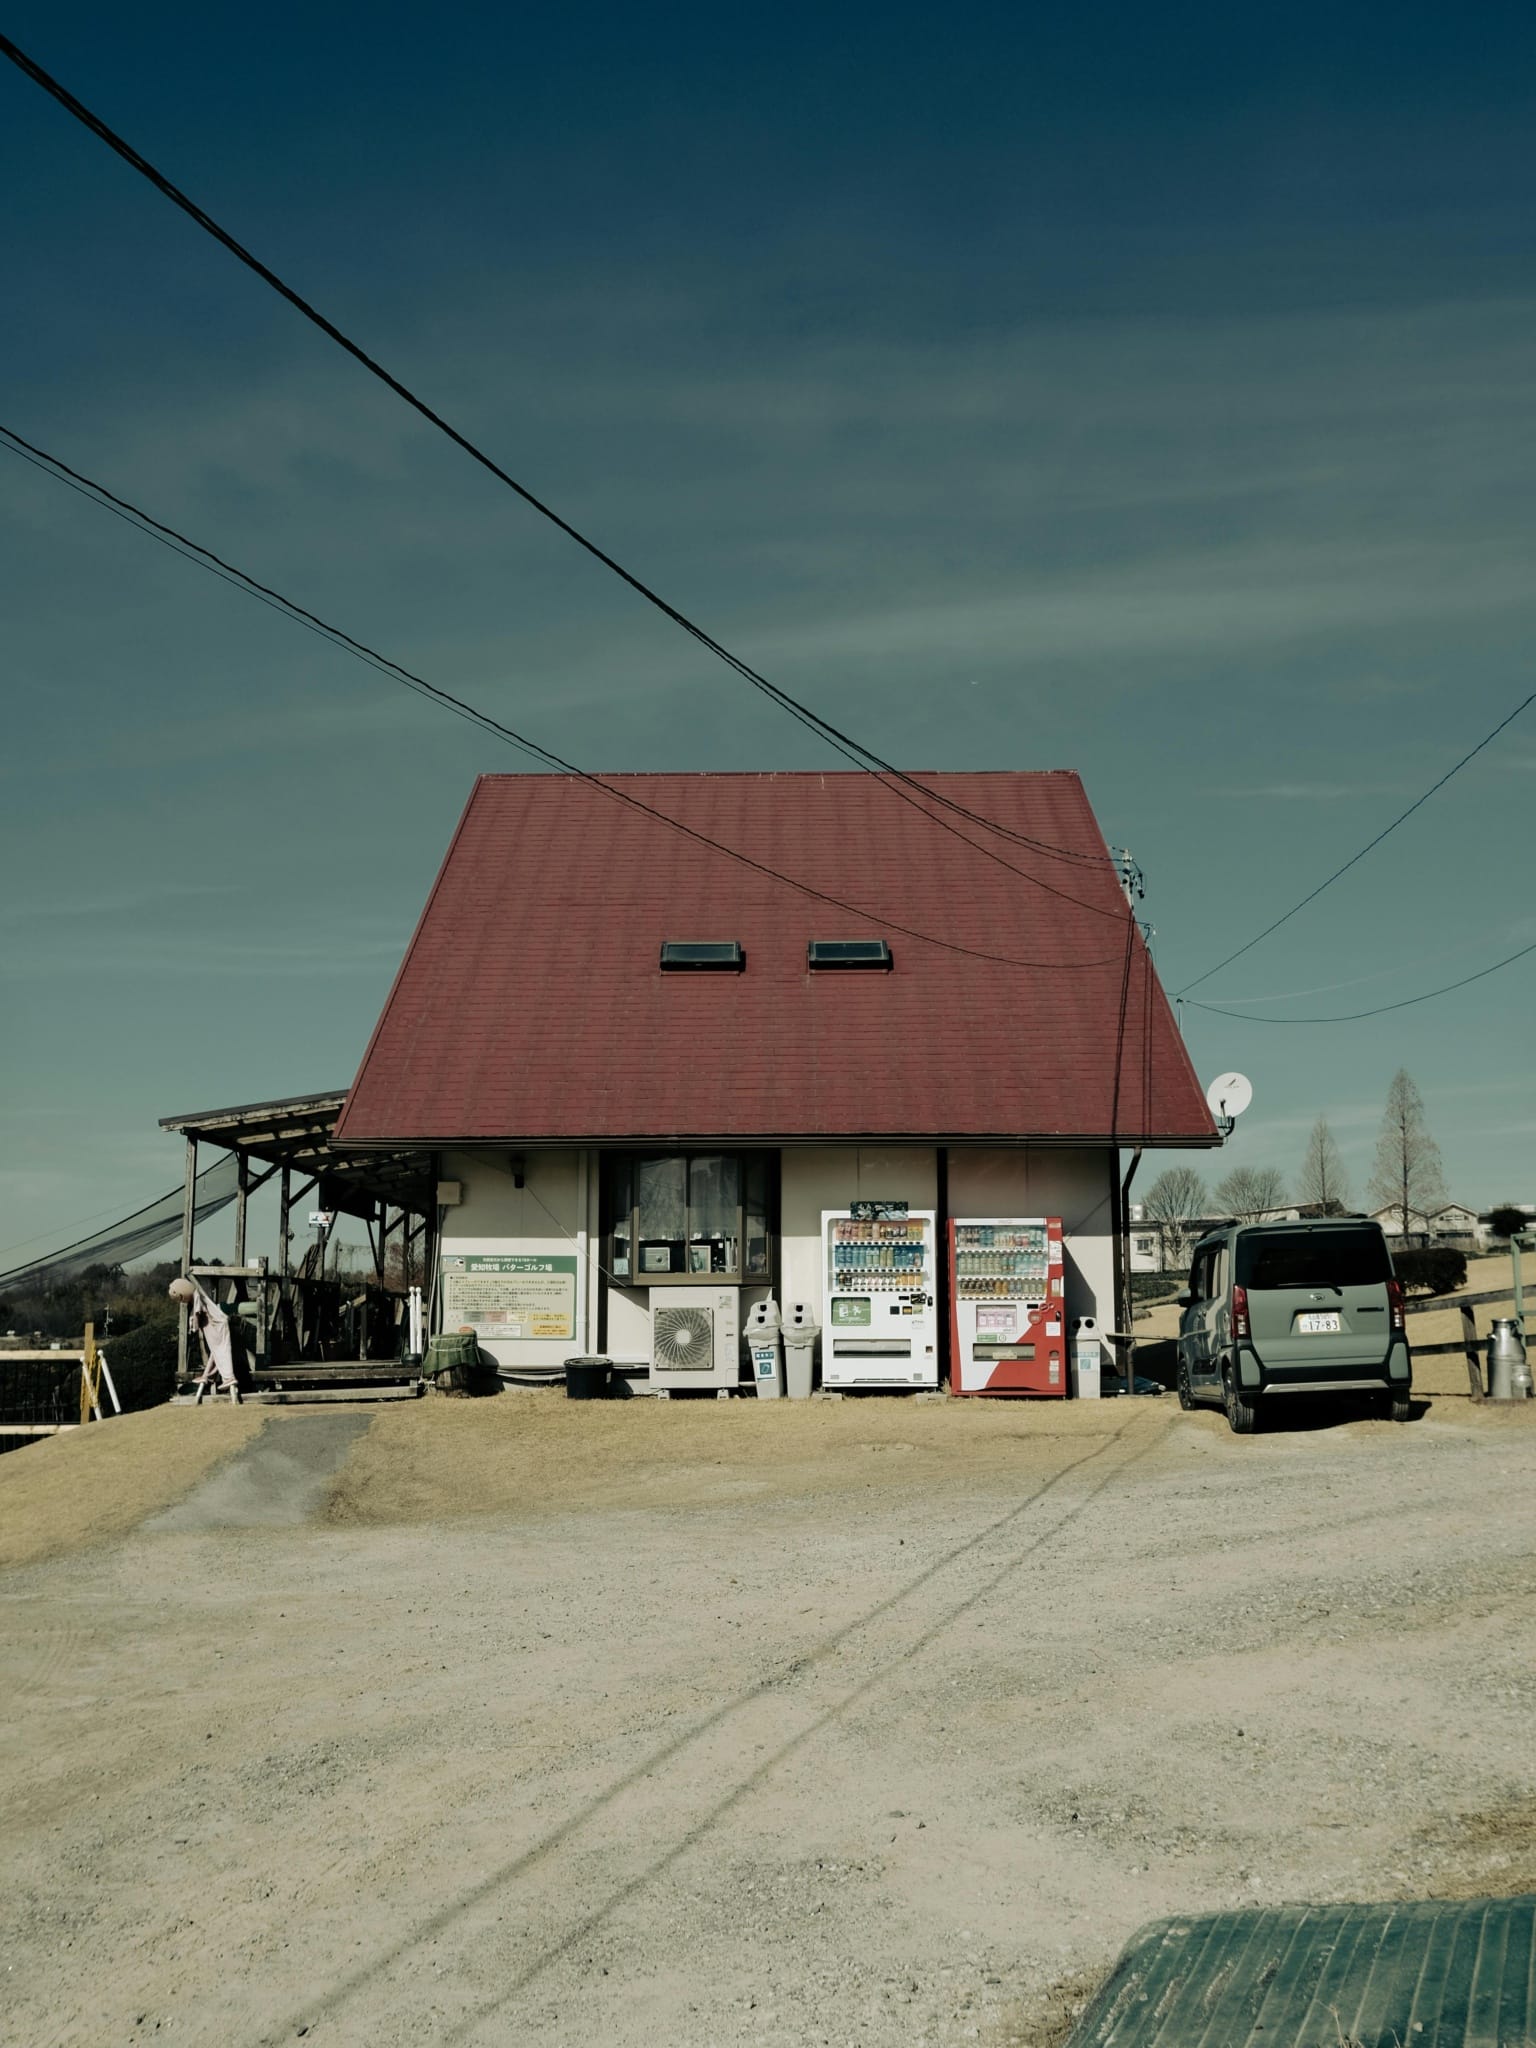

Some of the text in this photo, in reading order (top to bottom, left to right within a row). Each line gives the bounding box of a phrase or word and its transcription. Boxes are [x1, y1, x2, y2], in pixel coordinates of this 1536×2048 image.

[471, 1263, 499, 1272] 愛知牧場
[1310, 1320, 1338, 1330] 17-83
